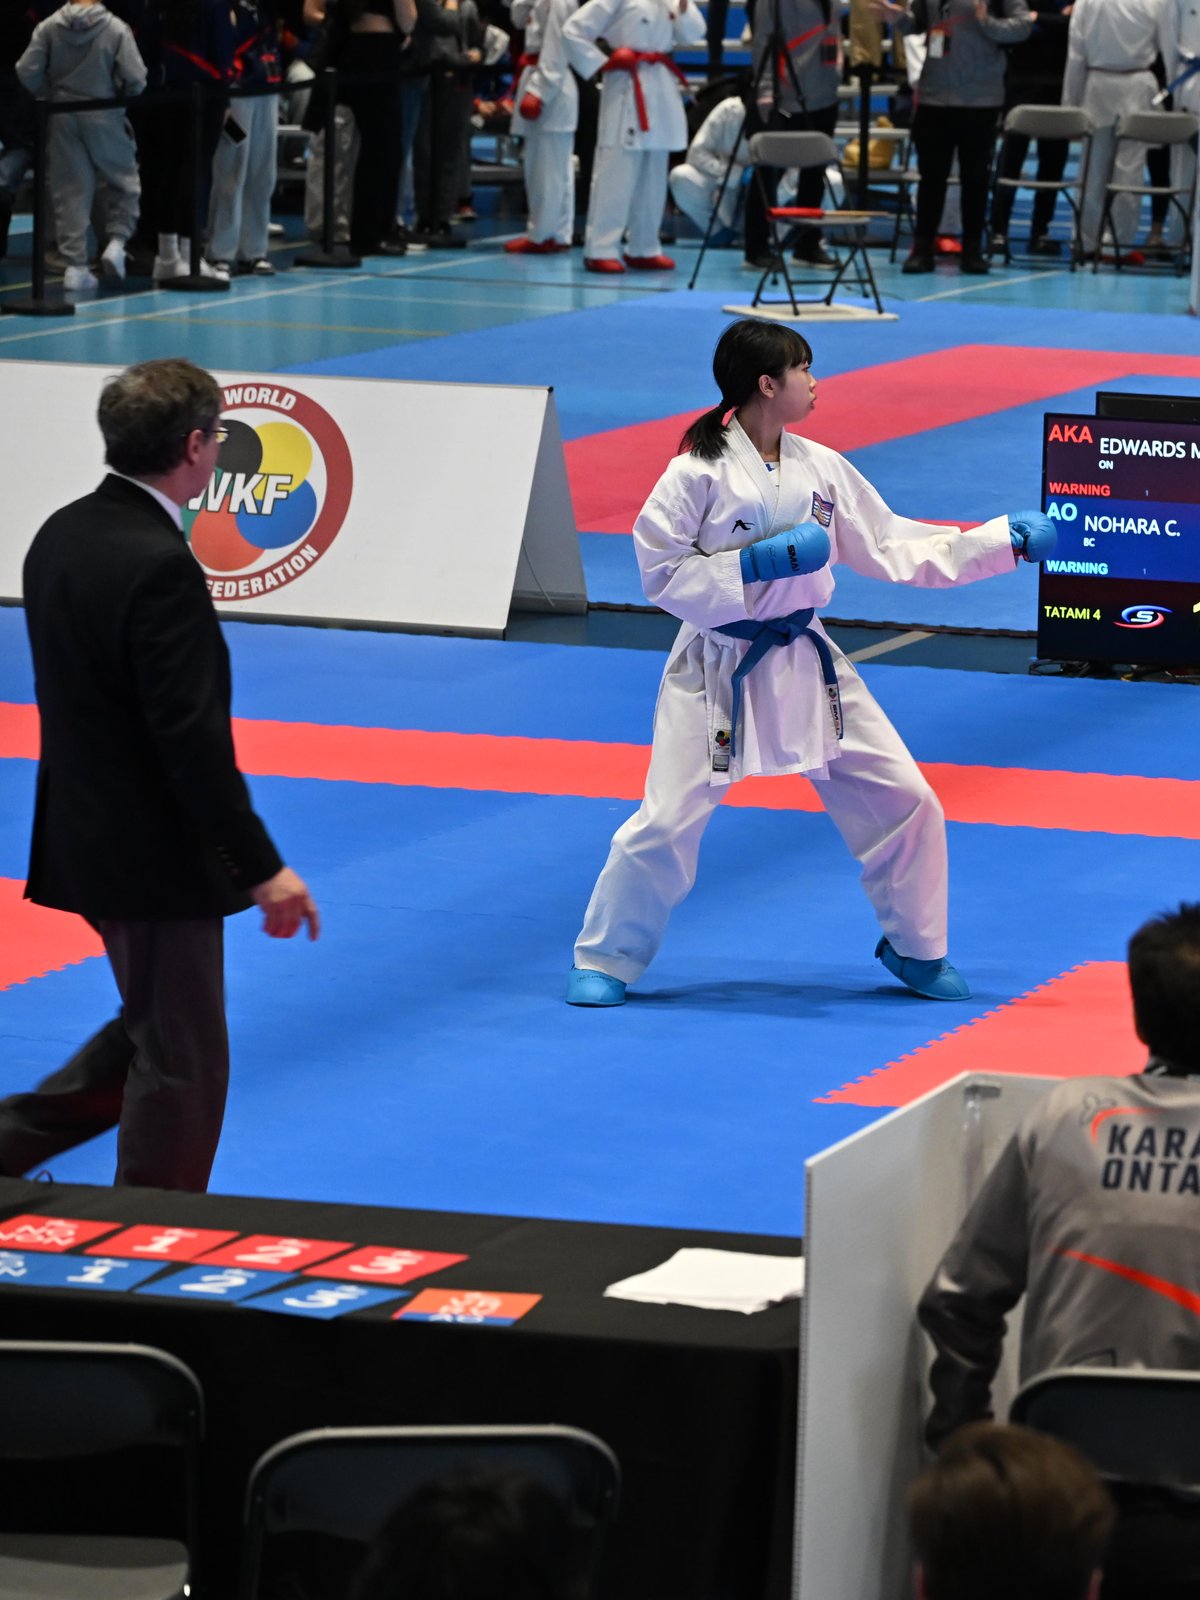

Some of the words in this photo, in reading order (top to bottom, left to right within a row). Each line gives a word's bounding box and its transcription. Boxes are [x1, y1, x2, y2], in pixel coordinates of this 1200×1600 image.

[224, 387, 297, 411] WORLD
[1048, 424, 1093, 444] AKA
[1100, 438, 1186, 459] EDWARDS
[1099, 460, 1114, 470] ON
[1049, 482, 1111, 497] WARNING
[1046, 502, 1078, 521] AO
[1084, 515, 1161, 536] NOHARA
[1165, 520, 1181, 537] C.
[1083, 538, 1096, 547] BC
[1046, 560, 1109, 575] WARNING
[1044, 605, 1091, 620] TATAMI
[1093, 609, 1101, 620] 4
[235, 1244, 302, 1265] 2
[179, 1274, 248, 1294] 2
